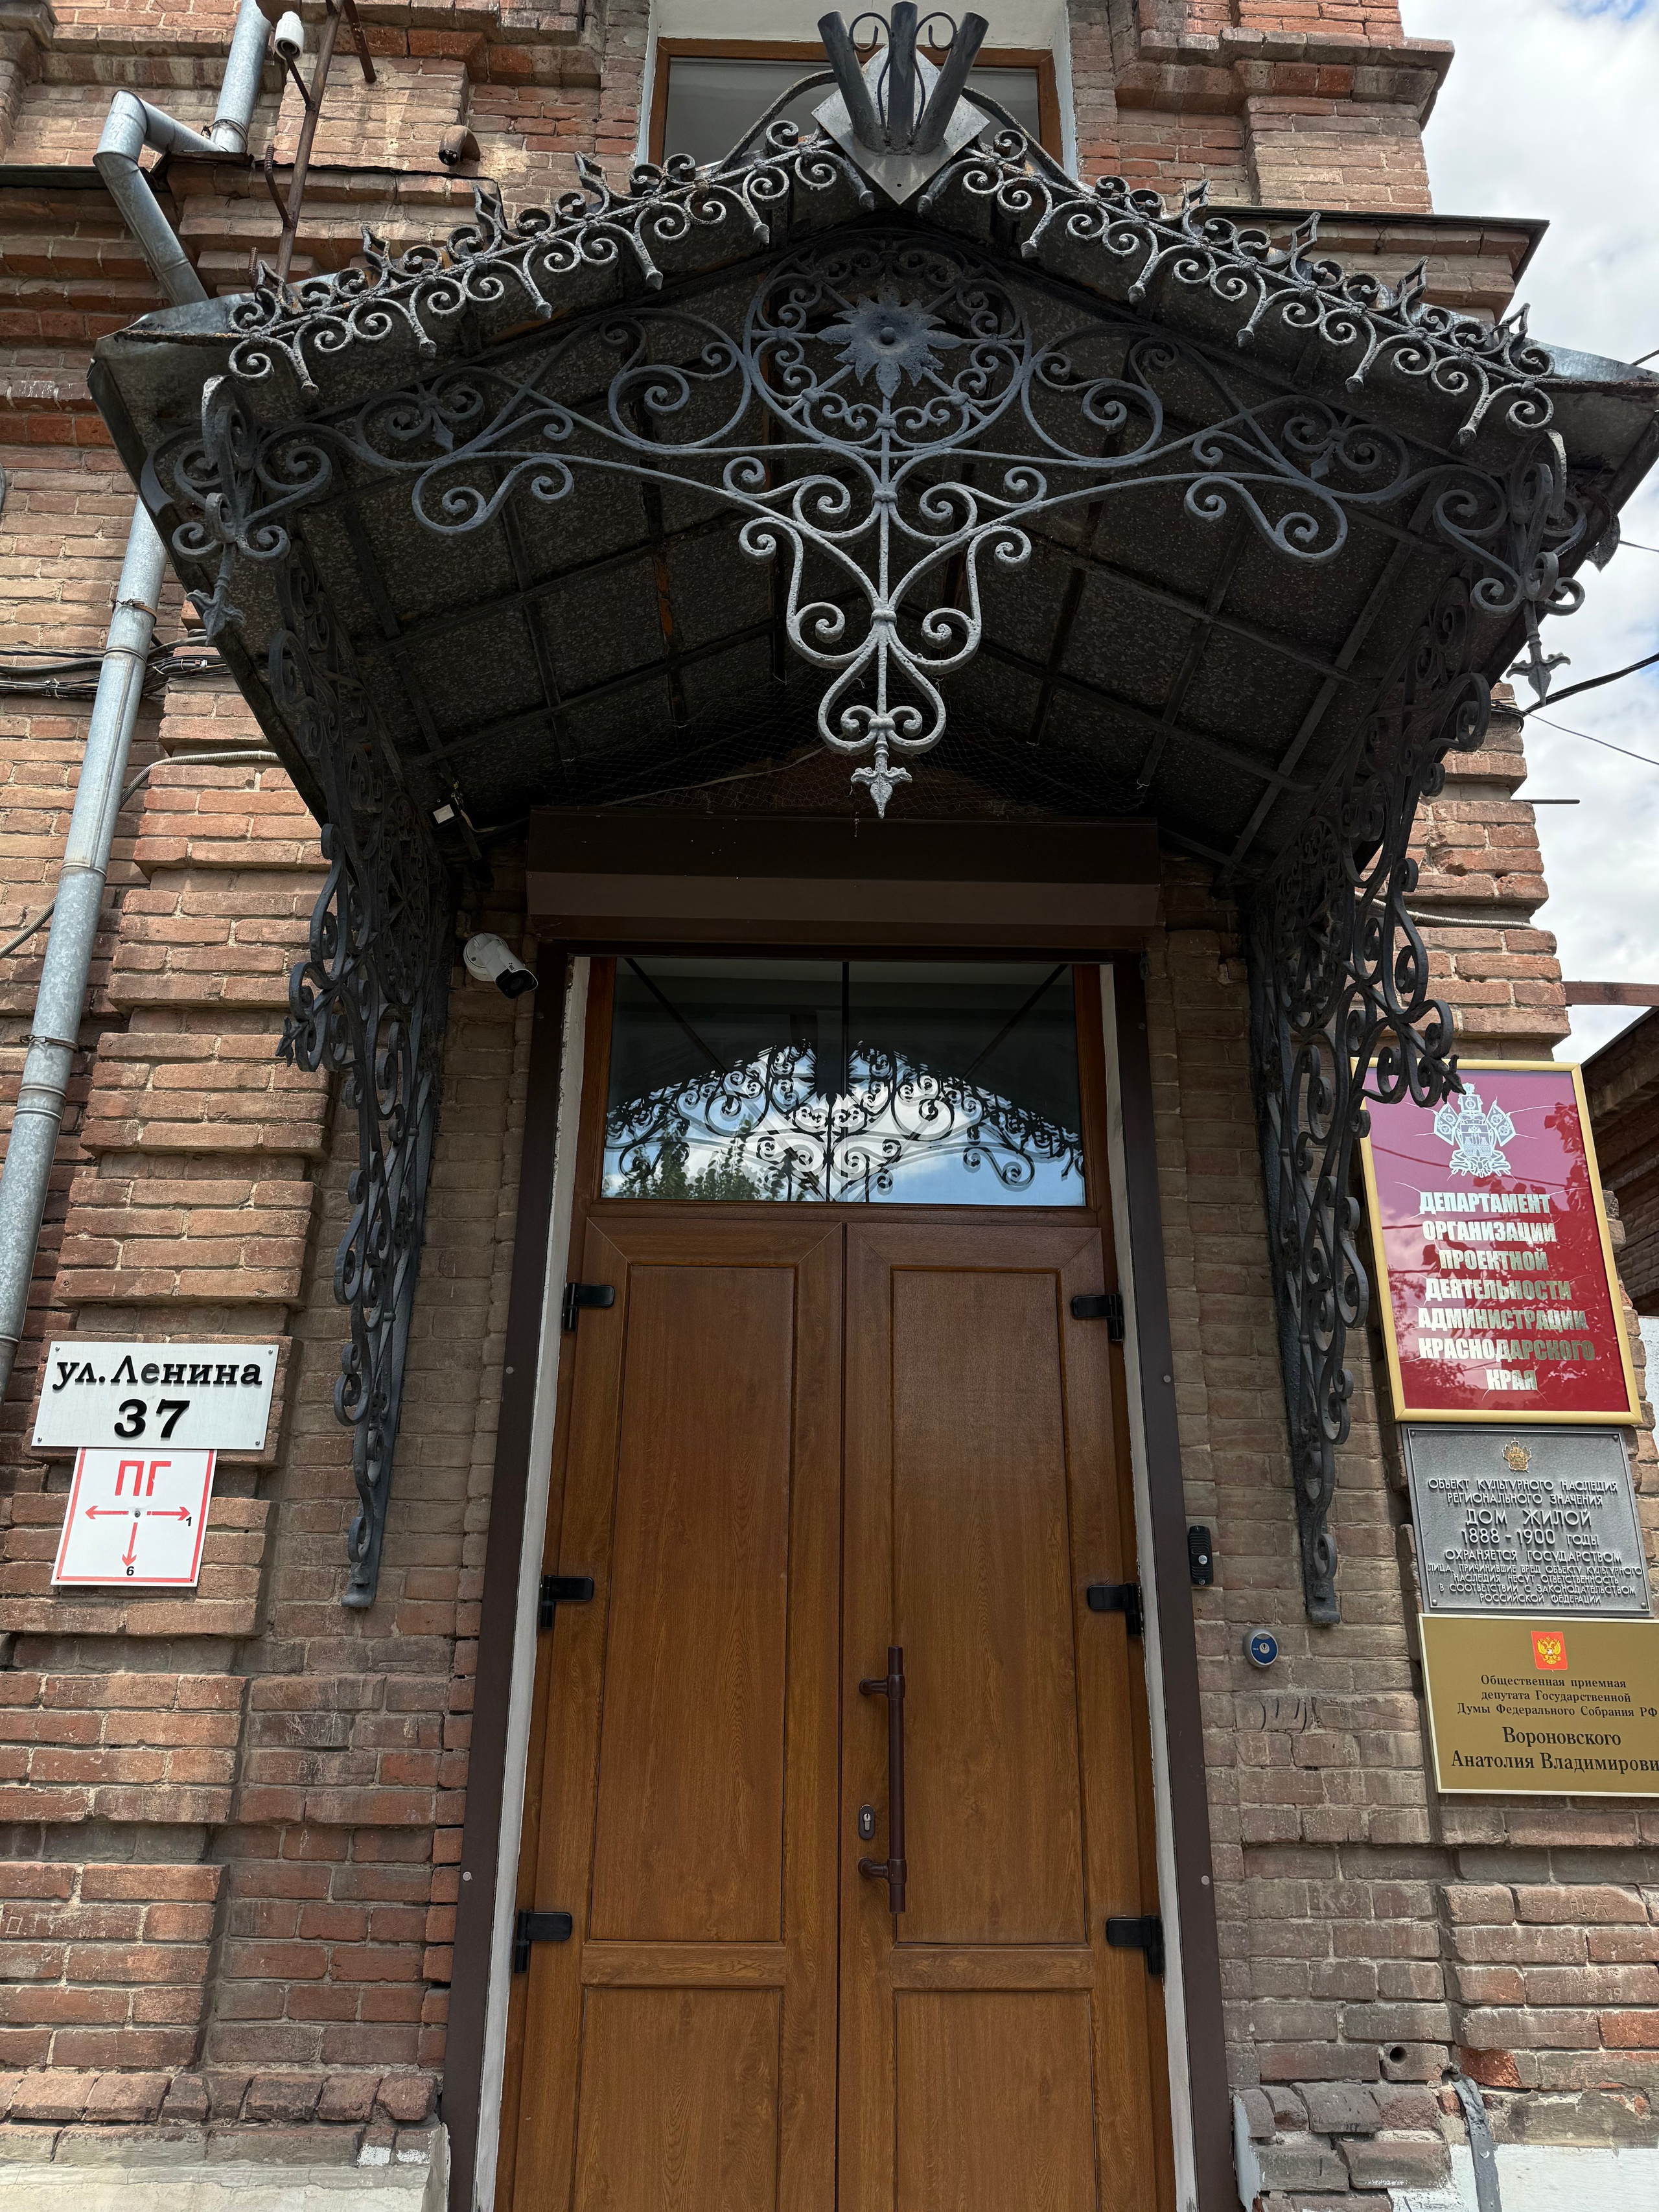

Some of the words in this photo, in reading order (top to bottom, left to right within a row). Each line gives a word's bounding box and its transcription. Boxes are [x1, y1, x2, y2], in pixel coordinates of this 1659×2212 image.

[1420, 1193, 1550, 1215] ДЕПАРТАМЕНТ
[1422, 1221, 1556, 1245] ОРГАНИЗАЦИИ
[1439, 1248, 1548, 1271] ПРОЕКТНОЙ
[1425, 1279, 1572, 1301] ДЕЯТЕЛЬНОСТИ
[1419, 1308, 1588, 1331] АДМИНИСТРАЦИИ
[1418, 1338, 1595, 1362] КРАСНОДАРСКОГО
[1485, 1369, 1537, 1390] КРАЯ
[114, 1399, 190, 1438] 37
[115, 1460, 172, 1496] ПГ
[1477, 1480, 1553, 1491] КУЛЬТУРНОГО
[1561, 1480, 1618, 1492] НАСЛЕДИЯ
[1446, 1493, 1542, 1504] РЕГИОНАЛЬНОГО
[1550, 1495, 1603, 1506] ЗНАЧЕНИЯ
[185, 1516, 192, 1527] 1
[1466, 1509, 1507, 1525] ДОМ
[1522, 1509, 1592, 1526] ЖИЛОЙ
[1461, 1528, 1500, 1544] 1888
[1517, 1528, 1555, 1544] 1900
[1445, 1549, 1517, 1561] ОХРАНЯЕТСЯ
[1527, 1550, 1621, 1563] ГОСУДАРСТВОМ
[126, 1565, 135, 1576] 6
[1459, 1564, 1516, 1573] ПРИЧИНИВШИЕ
[1520, 1565, 1541, 1574] ВРЕД
[1587, 1566, 1642, 1576] КУЛЬТУРНОГО
[1454, 1574, 1501, 1583] НАСЛЕДИЯ
[1508, 1575, 1535, 1583] НЕСУТ
[1541, 1575, 1619, 1585] ОТВЕТСТВЕННОСТЬ
[1439, 1583, 1444, 1592] В
[1450, 1583, 1518, 1592] СООТВЕТСТВИИ
[1537, 1585, 1636, 1595] ЗАКОНОДАТЕЛЬСТВОМ
[1479, 1592, 1544, 1603] РОССИЙСКОЙ
[1551, 1594, 1601, 1604] ФЕДЕРАЦИИ
[1481, 1674, 1565, 1686] Общественная
[1571, 1679, 1627, 1689] приемная
[1481, 1692, 1530, 1701] депутата
[1535, 1690, 1631, 1703] Государственной
[1457, 1703, 1491, 1715] Думы
[1496, 1703, 1575, 1717] Федерального
[1581, 1705, 1634, 1718] Собрания
[1640, 1706, 1658, 1717] РФ
[1502, 1726, 1621, 1747] Вороновского
[1451, 1750, 1535, 1769] Анатолия
